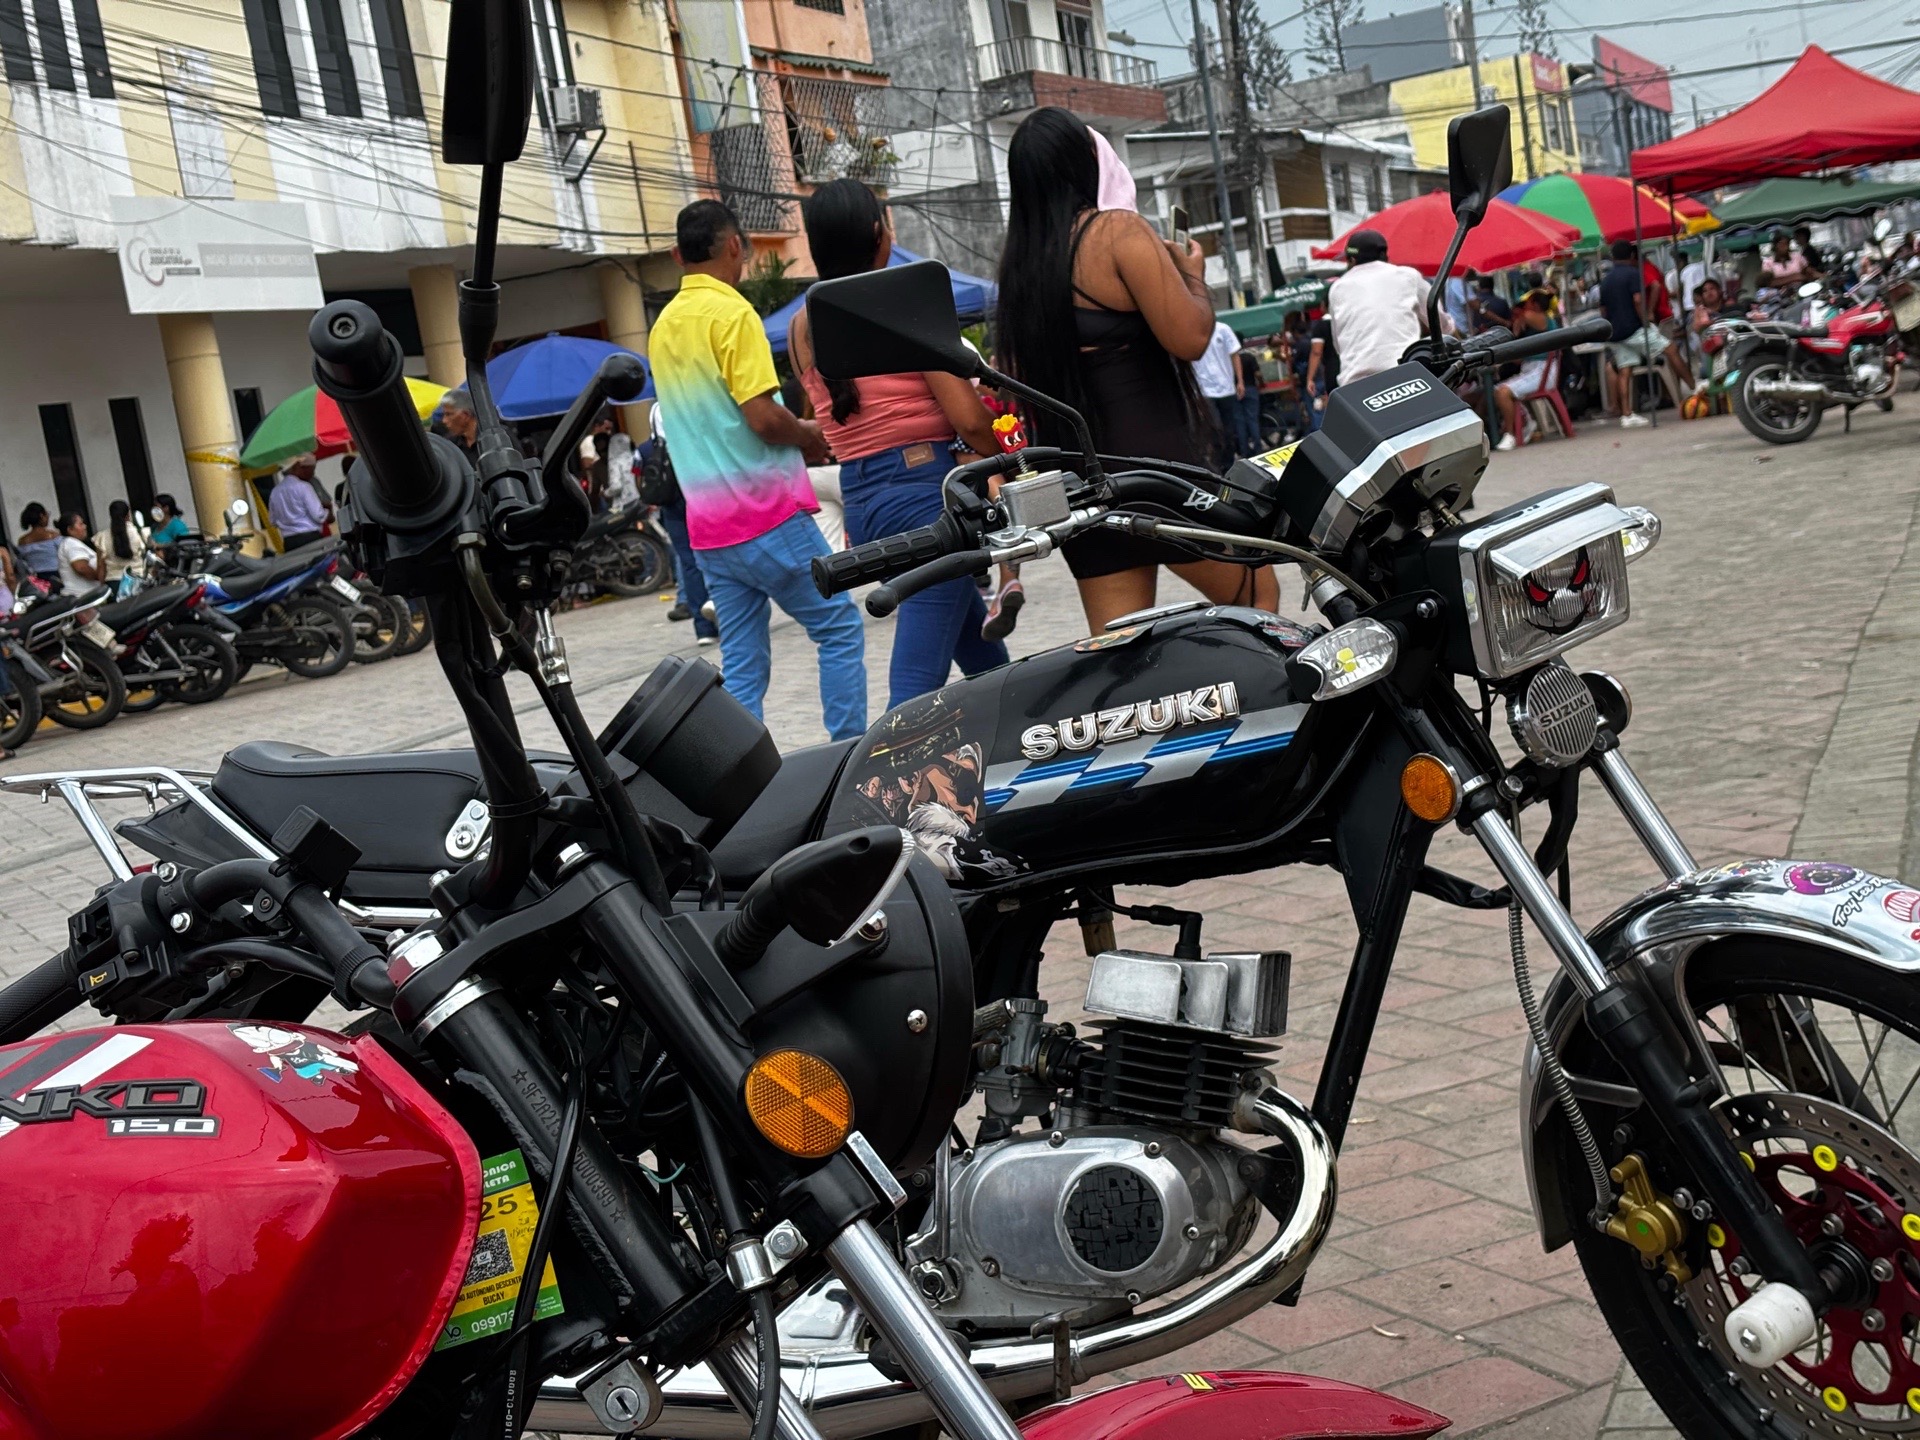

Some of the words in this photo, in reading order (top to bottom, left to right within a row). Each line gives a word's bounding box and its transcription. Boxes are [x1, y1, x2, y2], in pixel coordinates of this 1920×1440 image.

[1368, 380, 1426, 409] SUZUKI
[1021, 681, 1241, 761] SUZUKI
[1540, 693, 1590, 728] SUZUKI
[110, 1118, 215, 1134] 150
[481, 1193, 518, 1221] 25
[482, 1291, 505, 1306] BUCAY
